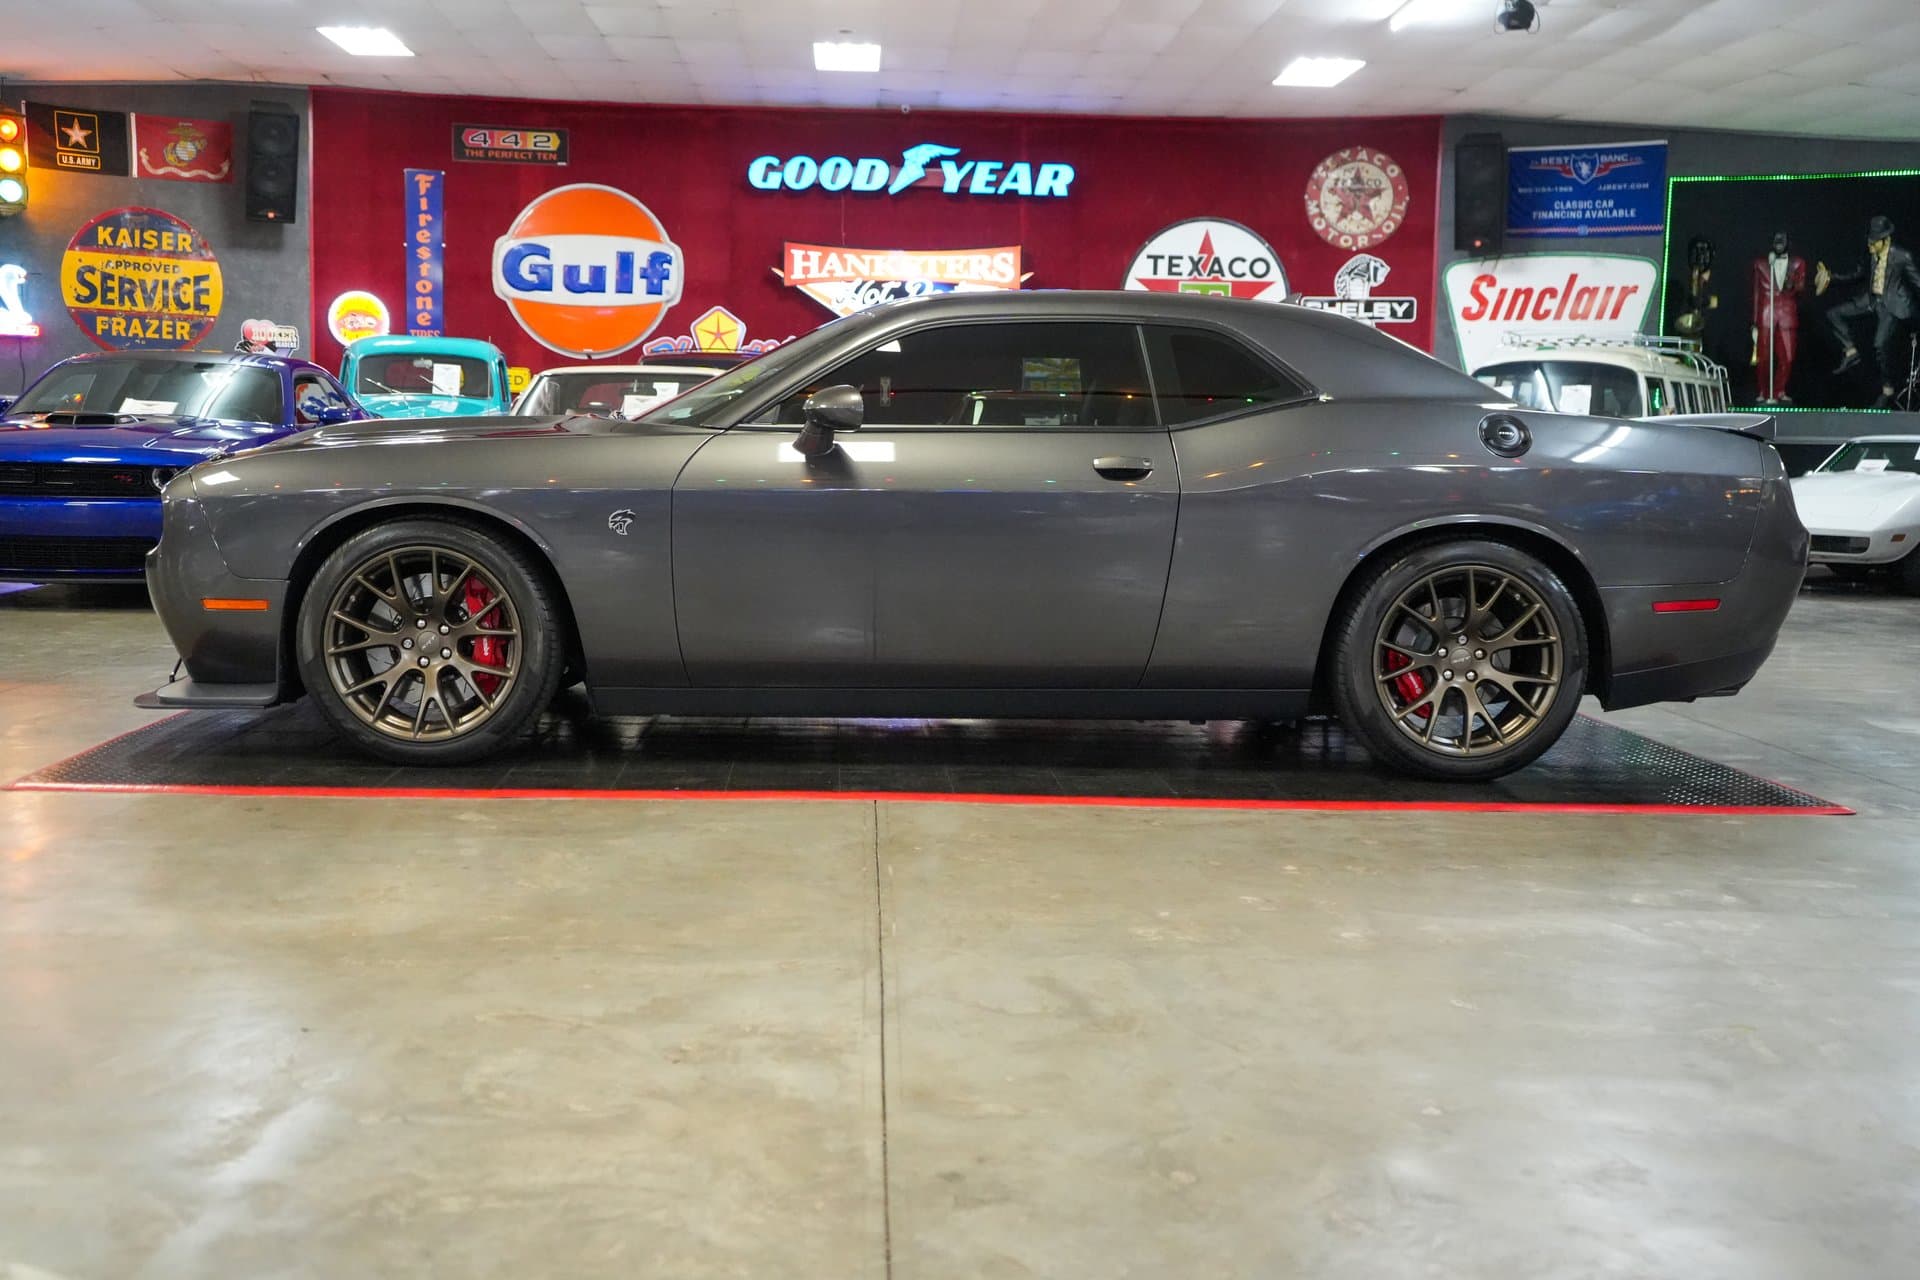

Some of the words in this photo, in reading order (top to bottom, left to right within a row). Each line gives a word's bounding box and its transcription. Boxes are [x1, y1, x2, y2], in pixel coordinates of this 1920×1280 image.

[76, 157, 97, 166] ARMY
[464, 149, 485, 157] THE
[488, 150, 534, 160] PERFECT
[537, 152, 558, 160] TEN
[1532, 210, 1583, 219] FINANCING
[1584, 207, 1637, 218] AVAILABLE
[1553, 199, 1593, 210] CLASSIC
[1595, 199, 1614, 209] CAR
[97, 226, 193, 252] KAISER
[414, 174, 435, 326] Firestone
[104, 260, 181, 274] APPROVED
[502, 243, 673, 296] Gulf
[1146, 254, 1271, 279] TEXACO
[75, 265, 210, 313] SERVICE
[1461, 273, 1640, 321] Sinclair
[96, 316, 191, 341] FRAZER
